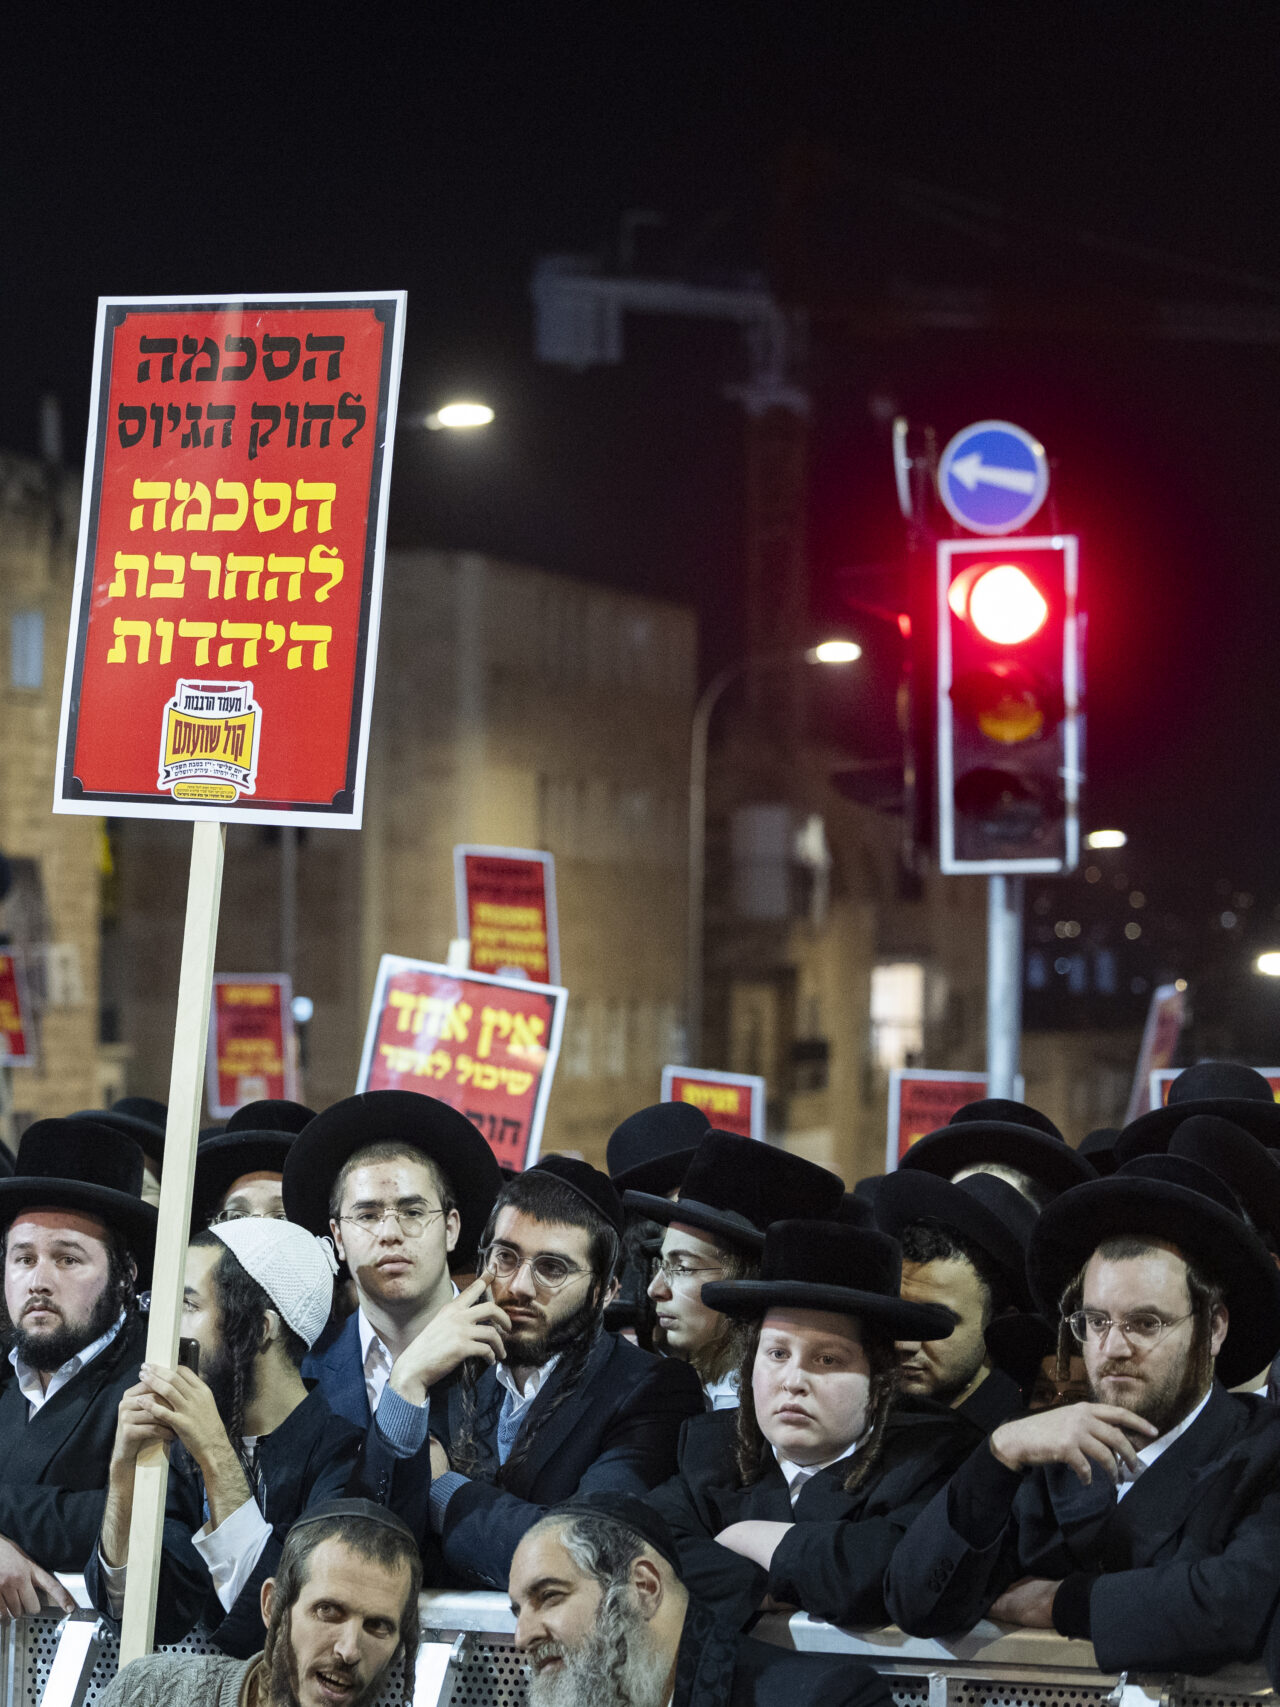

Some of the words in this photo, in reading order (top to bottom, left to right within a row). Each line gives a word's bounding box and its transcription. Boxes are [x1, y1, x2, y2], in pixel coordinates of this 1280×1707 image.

[137, 333, 345, 384] הסכמה
[117, 402, 236, 449] הגיוס
[248, 391, 368, 460] לחוק
[129, 478, 337, 534] הסכמה
[107, 545, 345, 603] להחרבת
[106, 617, 333, 671] היהדות
[184, 695, 216, 711] הרבבות
[217, 696, 242, 713] מעמד
[172, 719, 222, 757] שוועתם
[222, 720, 247, 762] קול
[388, 989, 473, 1043] אחד
[477, 1006, 546, 1059] אין
[455, 1053, 534, 1096] שיכול
